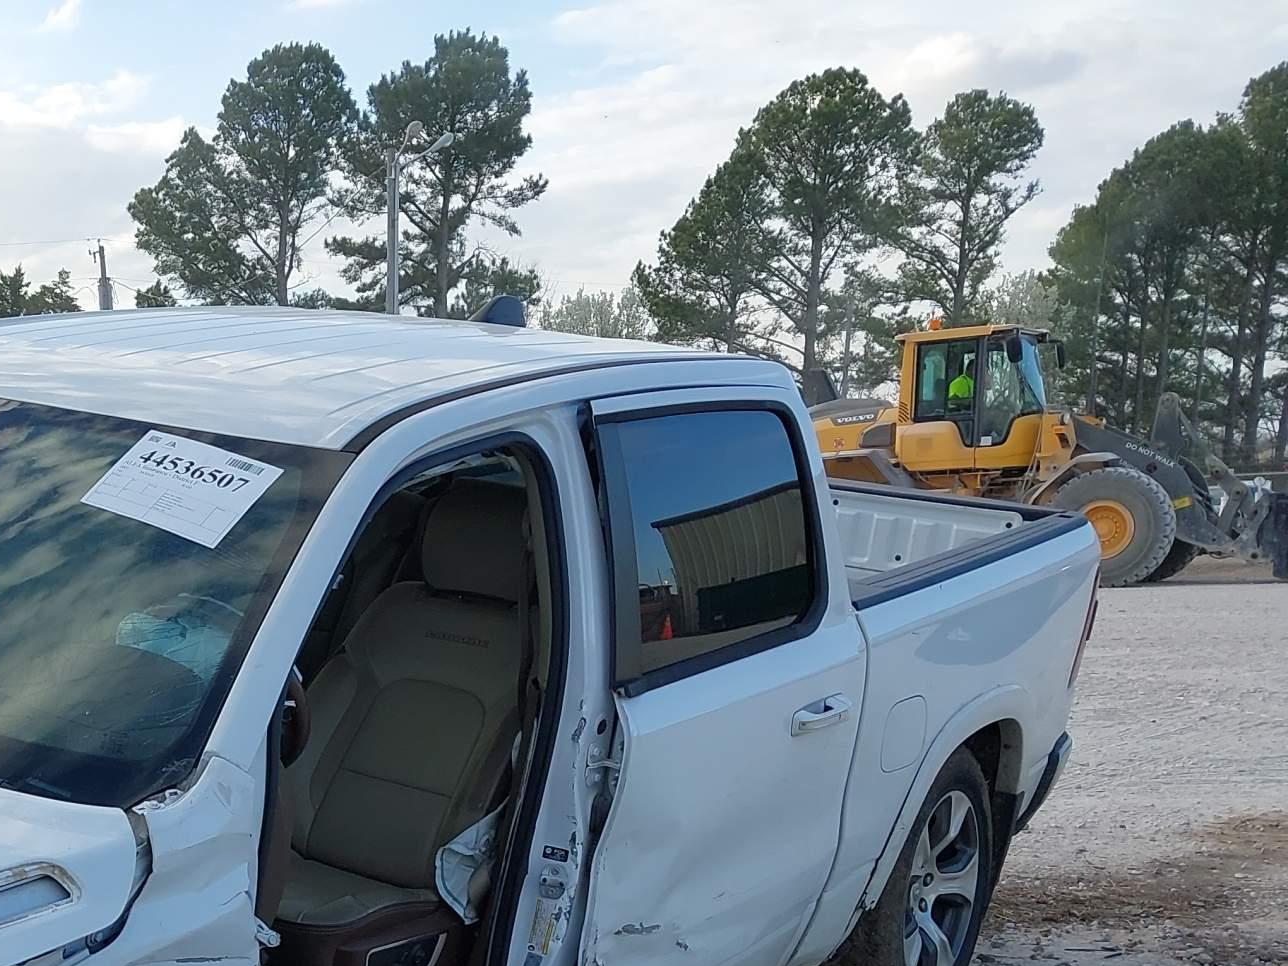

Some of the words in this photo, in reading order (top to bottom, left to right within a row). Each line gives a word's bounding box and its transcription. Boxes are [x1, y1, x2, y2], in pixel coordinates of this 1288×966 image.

[836, 413, 875, 423] VOLVO
[1125, 442, 1137, 451] DO
[1138, 446, 1155, 457] NOT
[1155, 455, 1176, 468] WALK
[139, 450, 251, 493] 44536507
